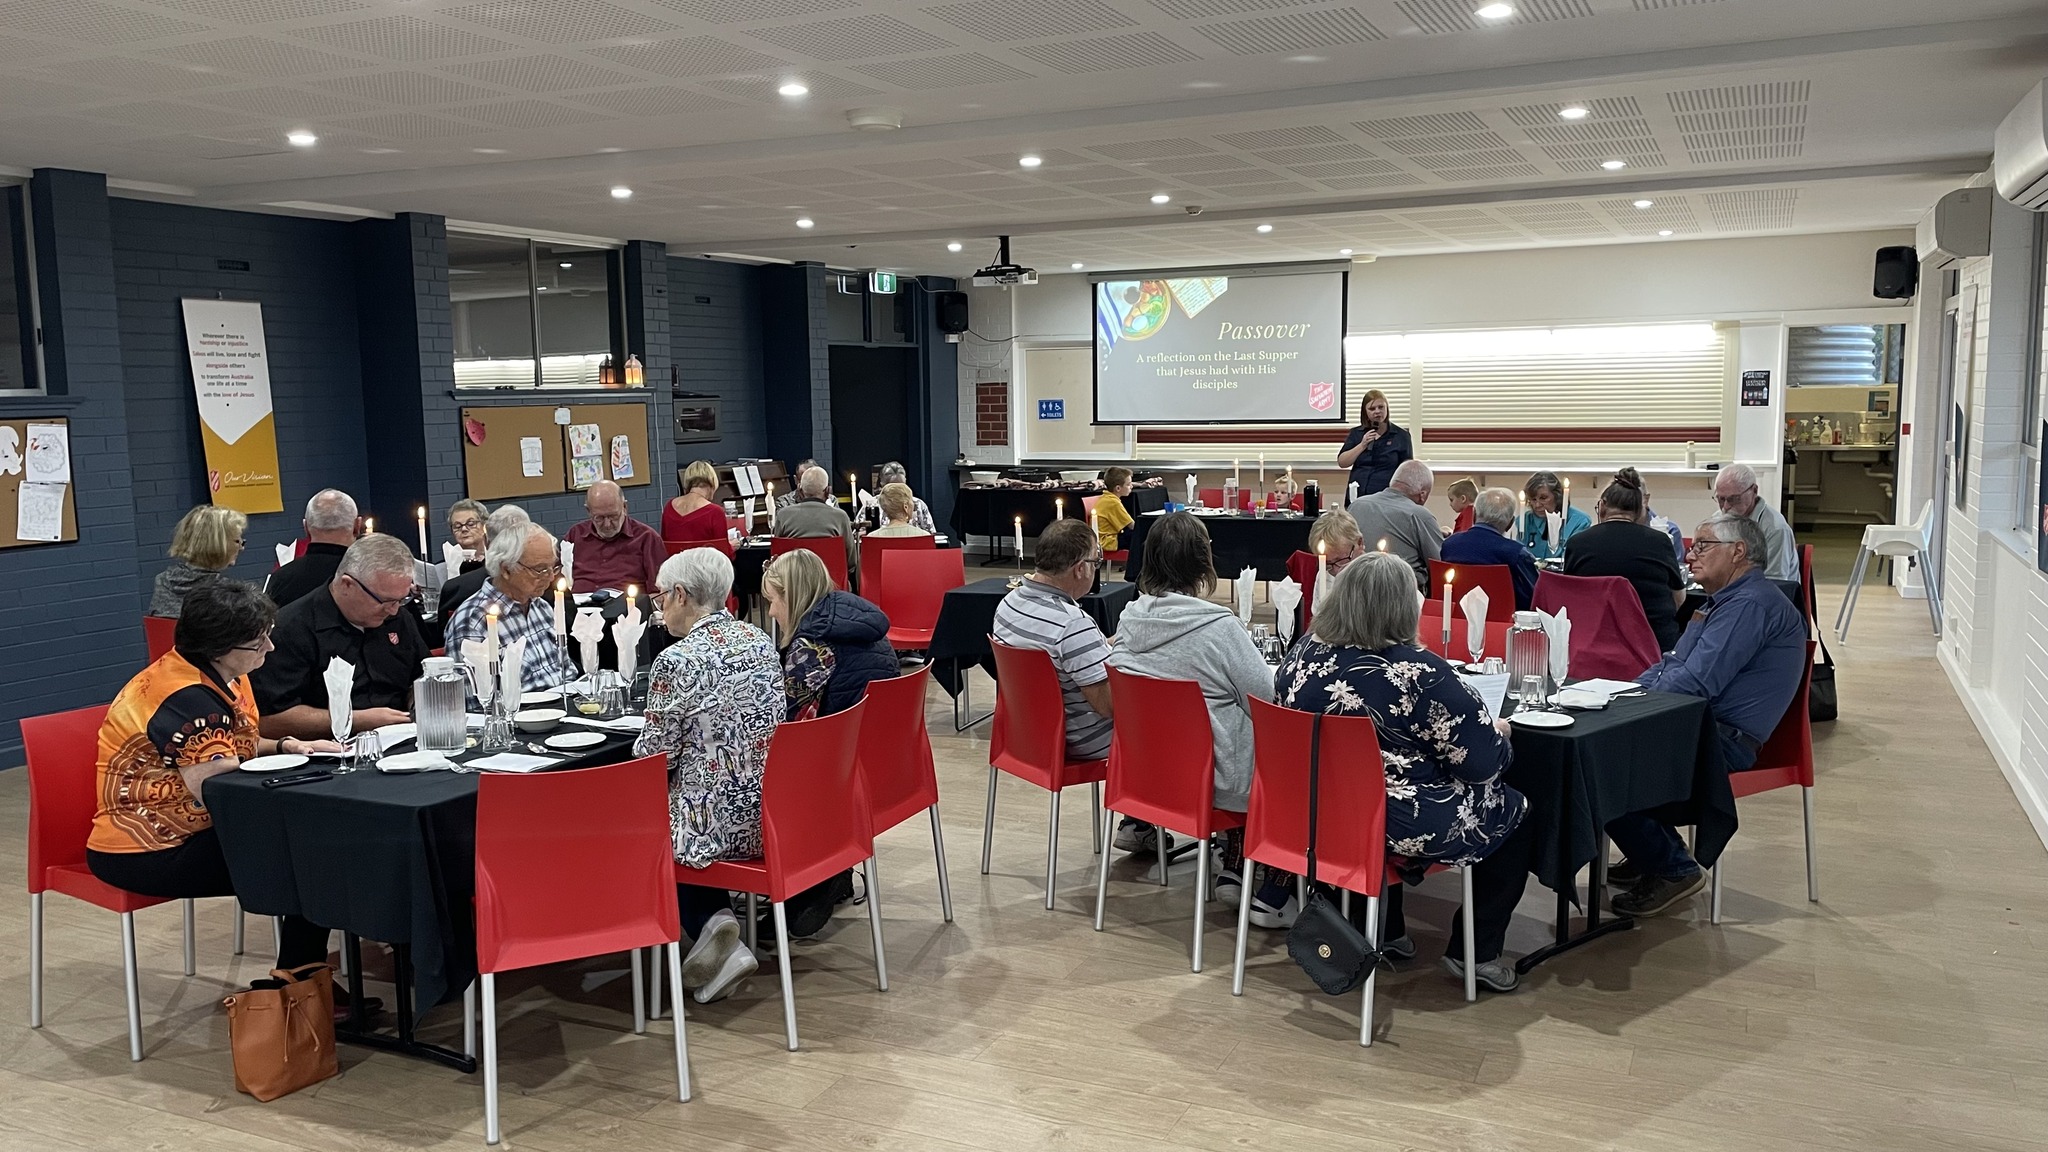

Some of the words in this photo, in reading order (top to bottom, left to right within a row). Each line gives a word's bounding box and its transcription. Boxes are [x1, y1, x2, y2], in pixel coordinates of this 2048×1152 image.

[1217, 321, 1311, 340] Passover
[1136, 353, 1144, 363] A
[1146, 352, 1196, 362] reflection
[1198, 354, 1211, 362] on
[1214, 350, 1232, 361] the
[1234, 351, 1256, 360] Last
[1259, 350, 1299, 362] Supper
[1156, 365, 1177, 376] that
[1179, 366, 1207, 377] Jesus
[1209, 365, 1229, 375] had
[1231, 364, 1255, 374] with
[1258, 364, 1277, 374] His
[1192, 379, 1238, 391] disciples
[224, 471, 242, 484] Our
[242, 470, 274, 483] Vision
